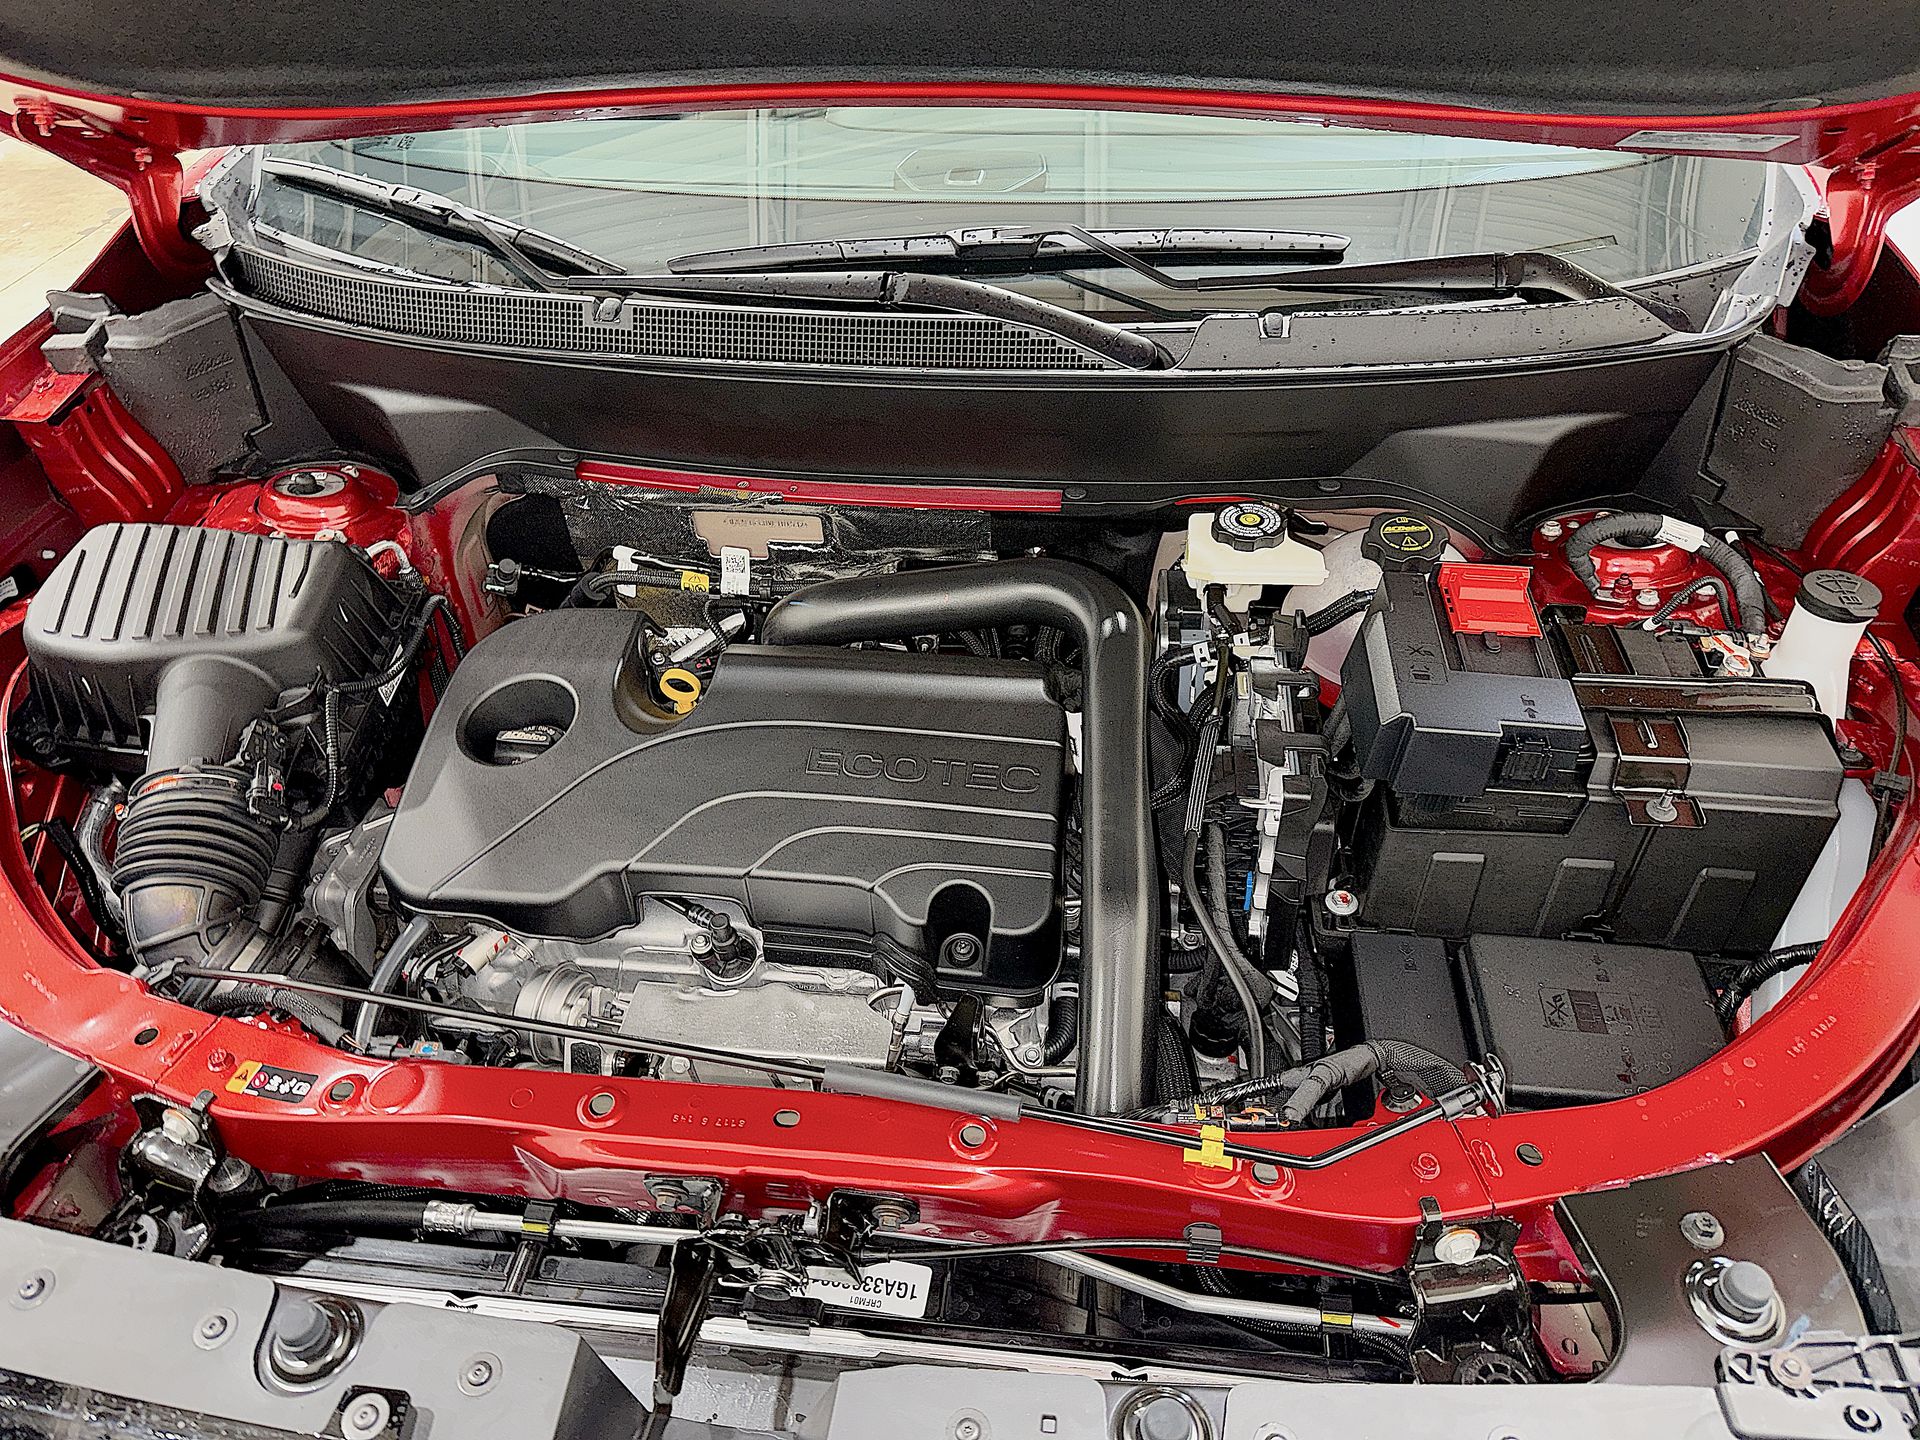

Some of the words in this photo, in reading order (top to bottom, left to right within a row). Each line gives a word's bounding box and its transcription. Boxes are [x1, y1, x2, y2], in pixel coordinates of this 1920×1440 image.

[1382, 525, 1429, 534] ACDelco
[500, 730, 547, 742] ACDelco
[805, 746, 1041, 793] ECOTEC
[849, 1295, 882, 1309] CRFM01
